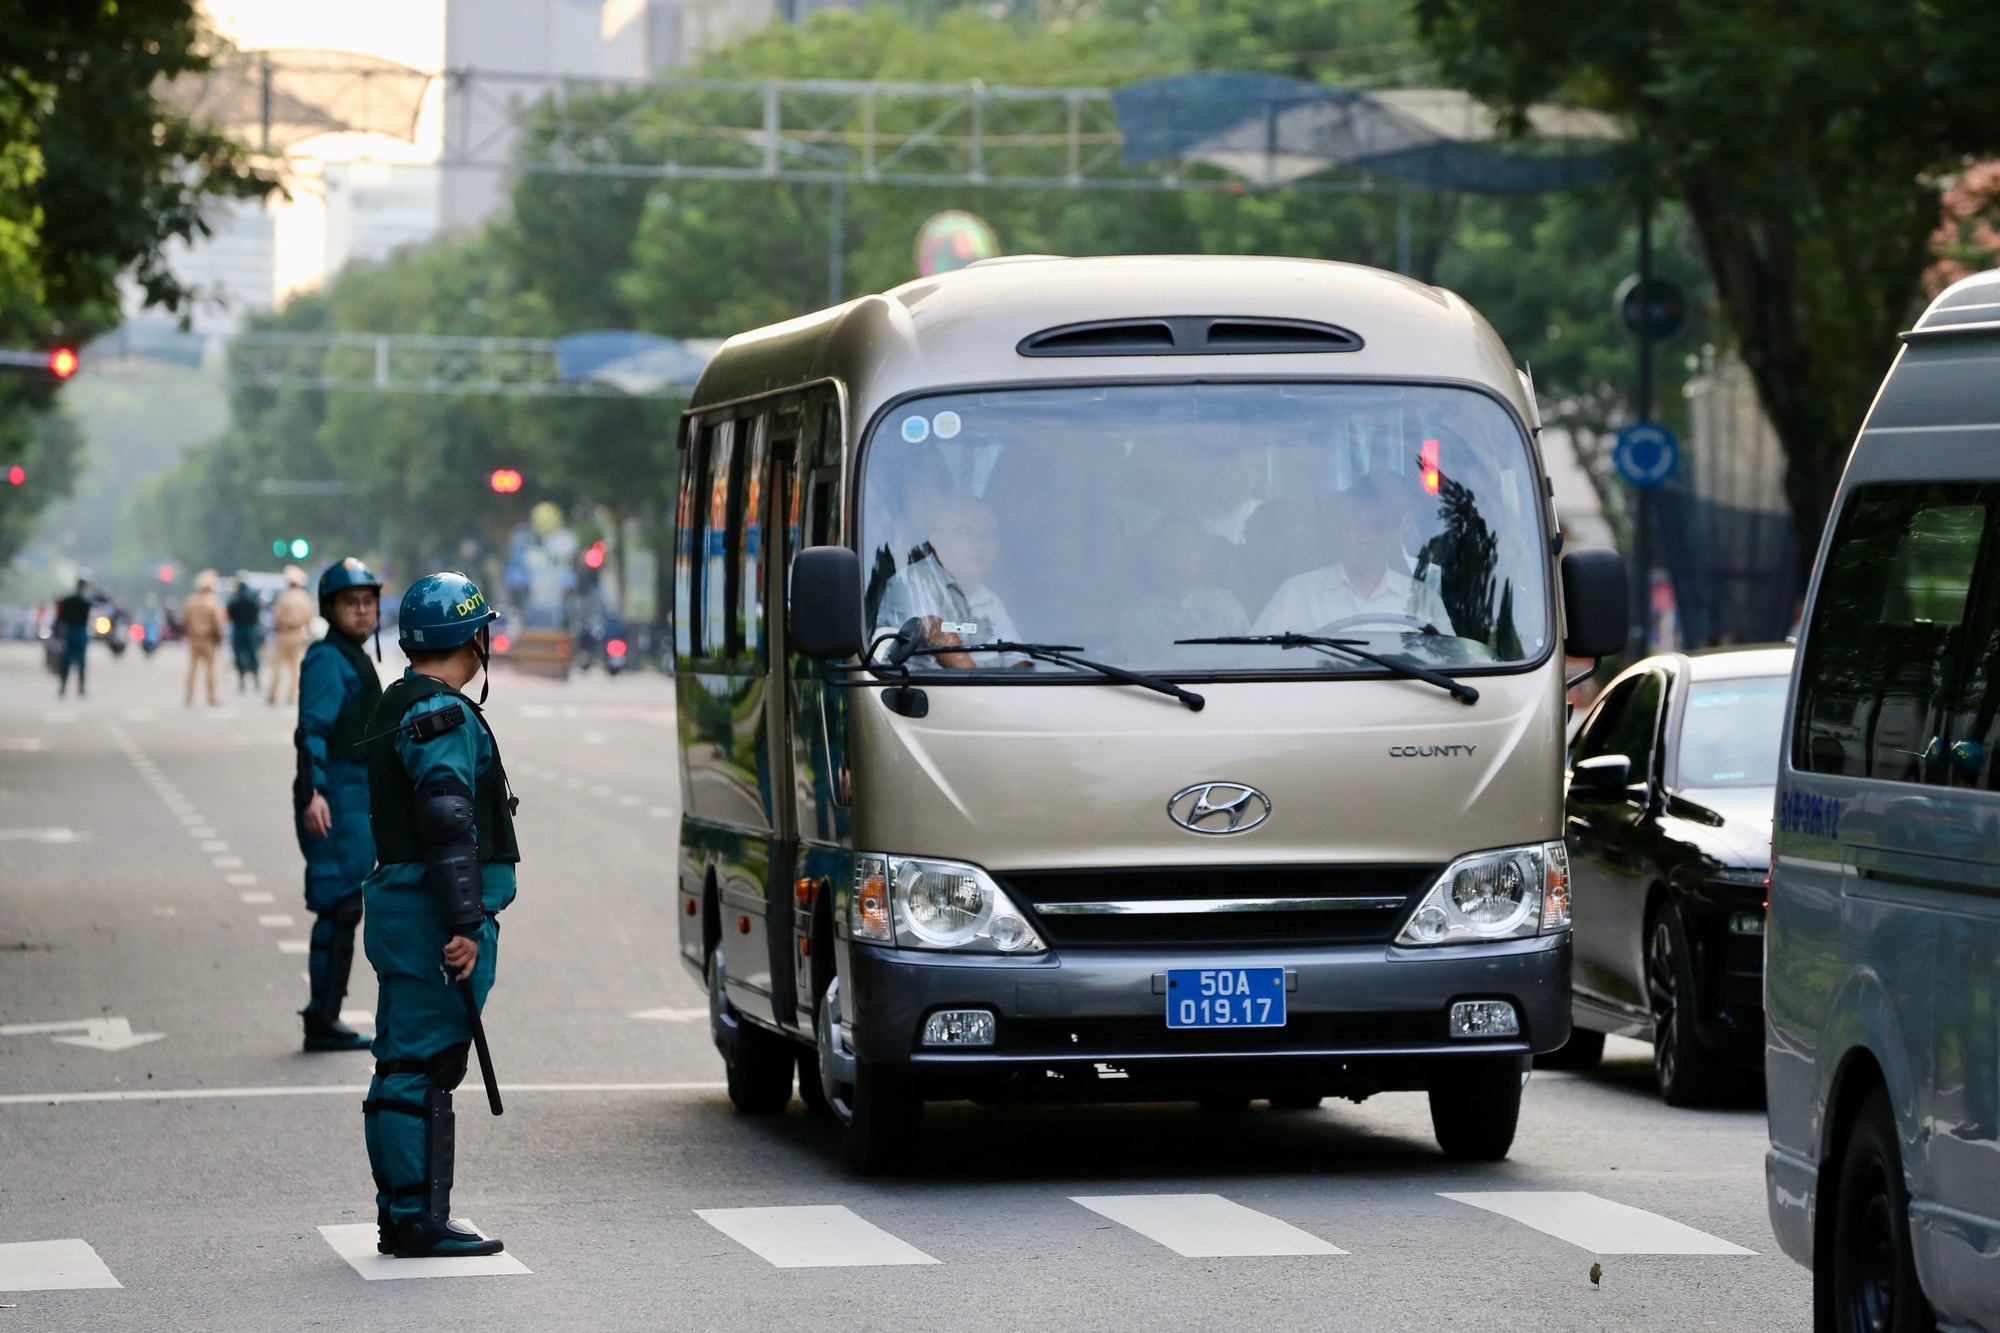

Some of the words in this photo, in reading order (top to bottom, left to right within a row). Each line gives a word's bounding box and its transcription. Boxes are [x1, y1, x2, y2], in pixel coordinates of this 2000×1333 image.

[1389, 744, 1477, 757] COUNTY
[1201, 971, 1250, 996] 50A
[1180, 998, 1272, 1024] 019.17
